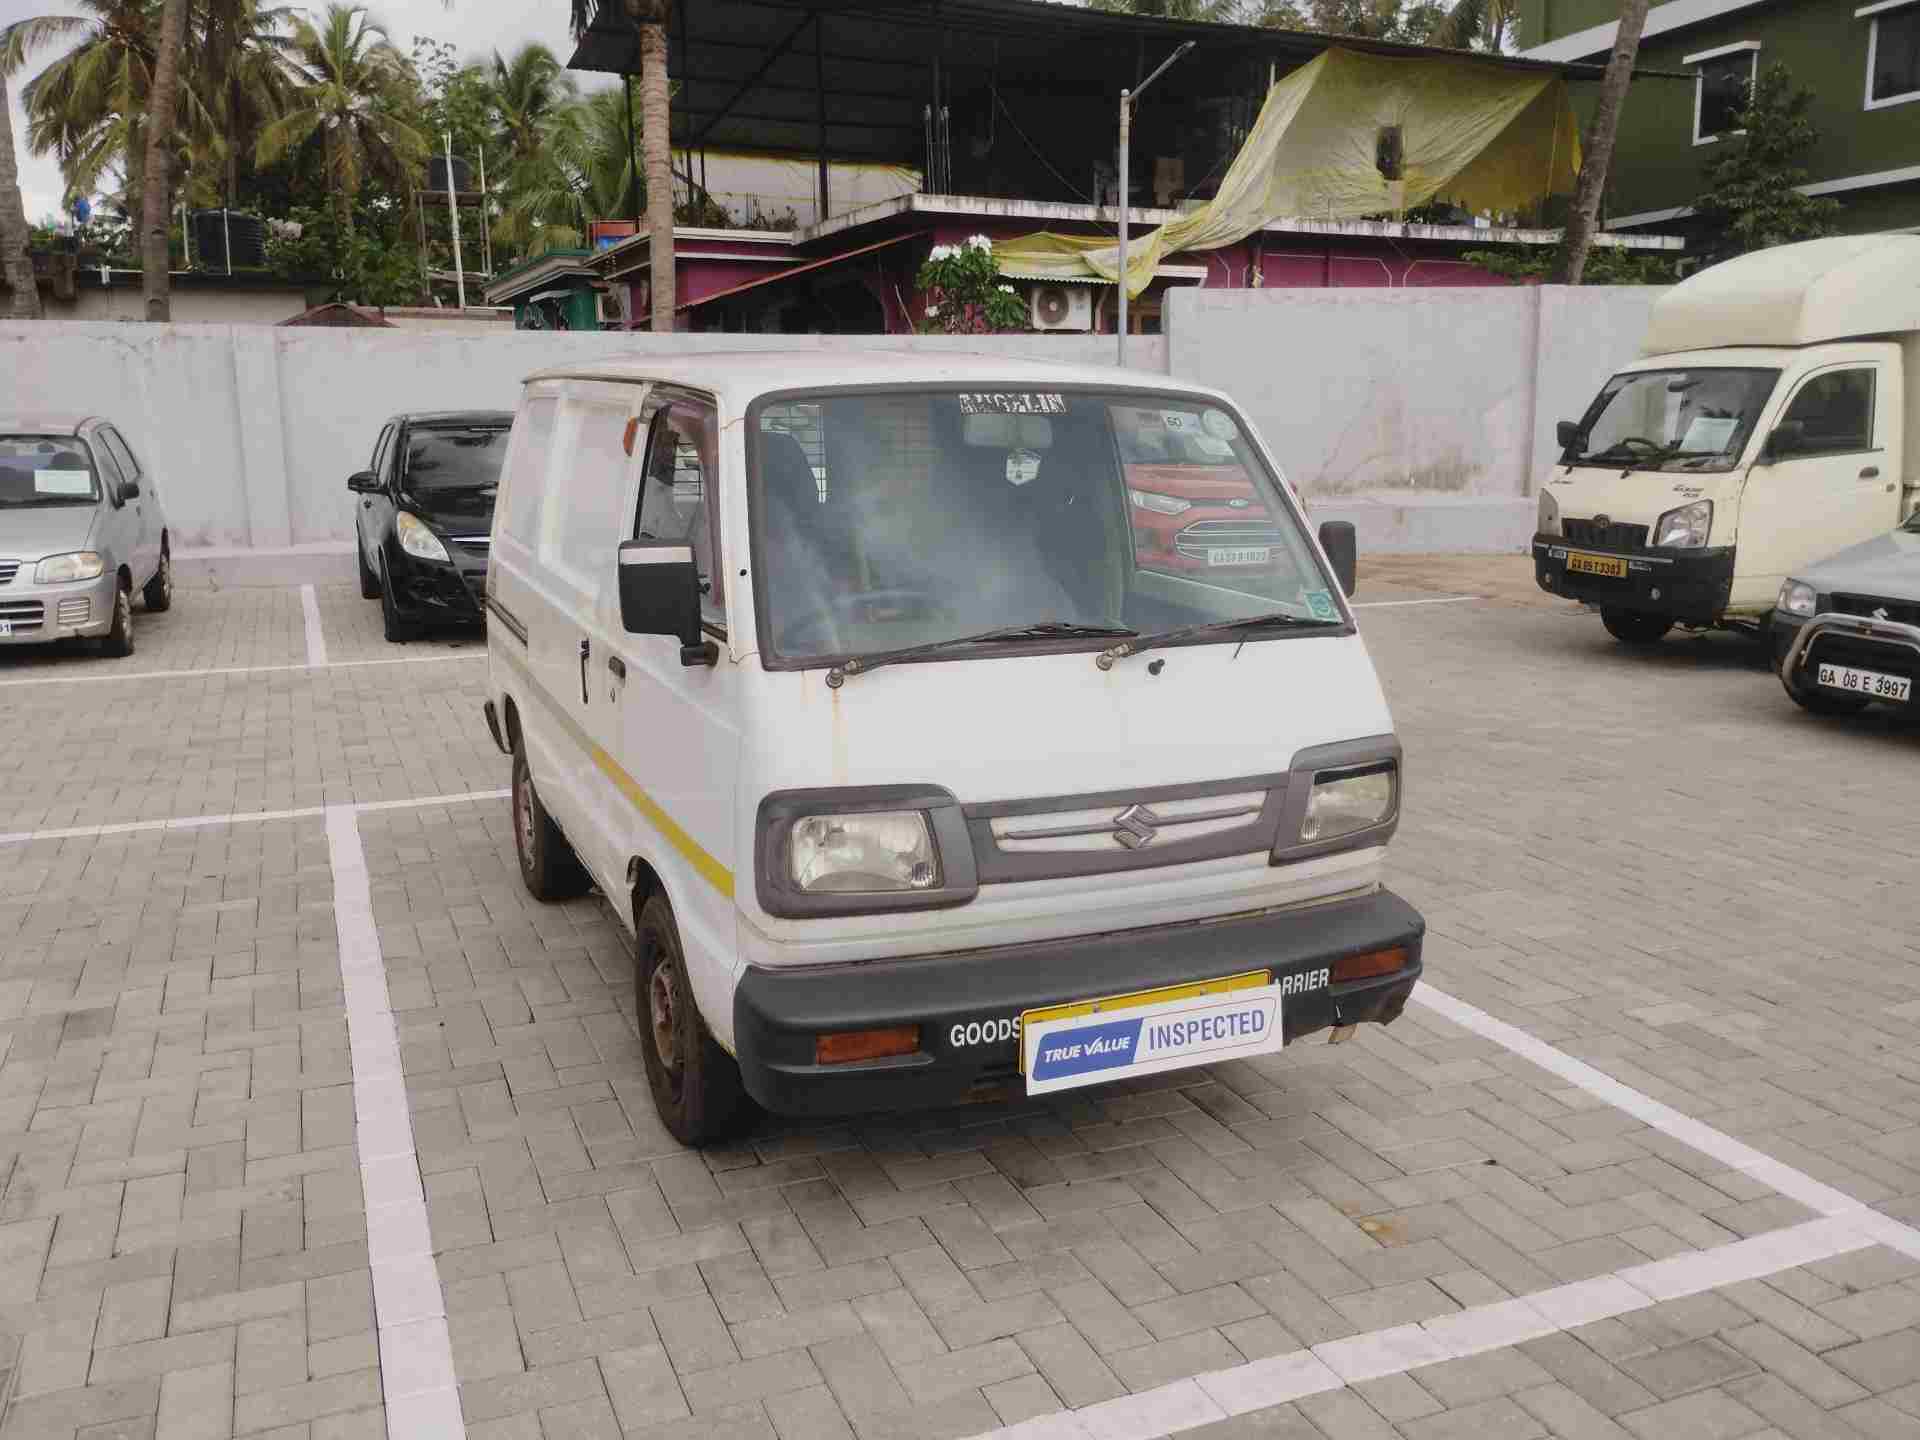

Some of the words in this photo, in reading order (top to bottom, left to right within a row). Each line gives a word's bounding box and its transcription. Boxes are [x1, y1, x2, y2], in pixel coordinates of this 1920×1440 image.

[1820, 668, 1836, 684] GA
[1843, 671, 1858, 689] 08
[1863, 676, 1871, 690] E
[1876, 676, 1908, 698] 3997
[950, 1016, 1021, 1047] GOODS
[1274, 968, 1329, 996] RRIER
[1045, 1045, 1081, 1063] TRUE
[1084, 1036, 1131, 1057] VALUE
[1149, 1009, 1265, 1050] INSPECTED
